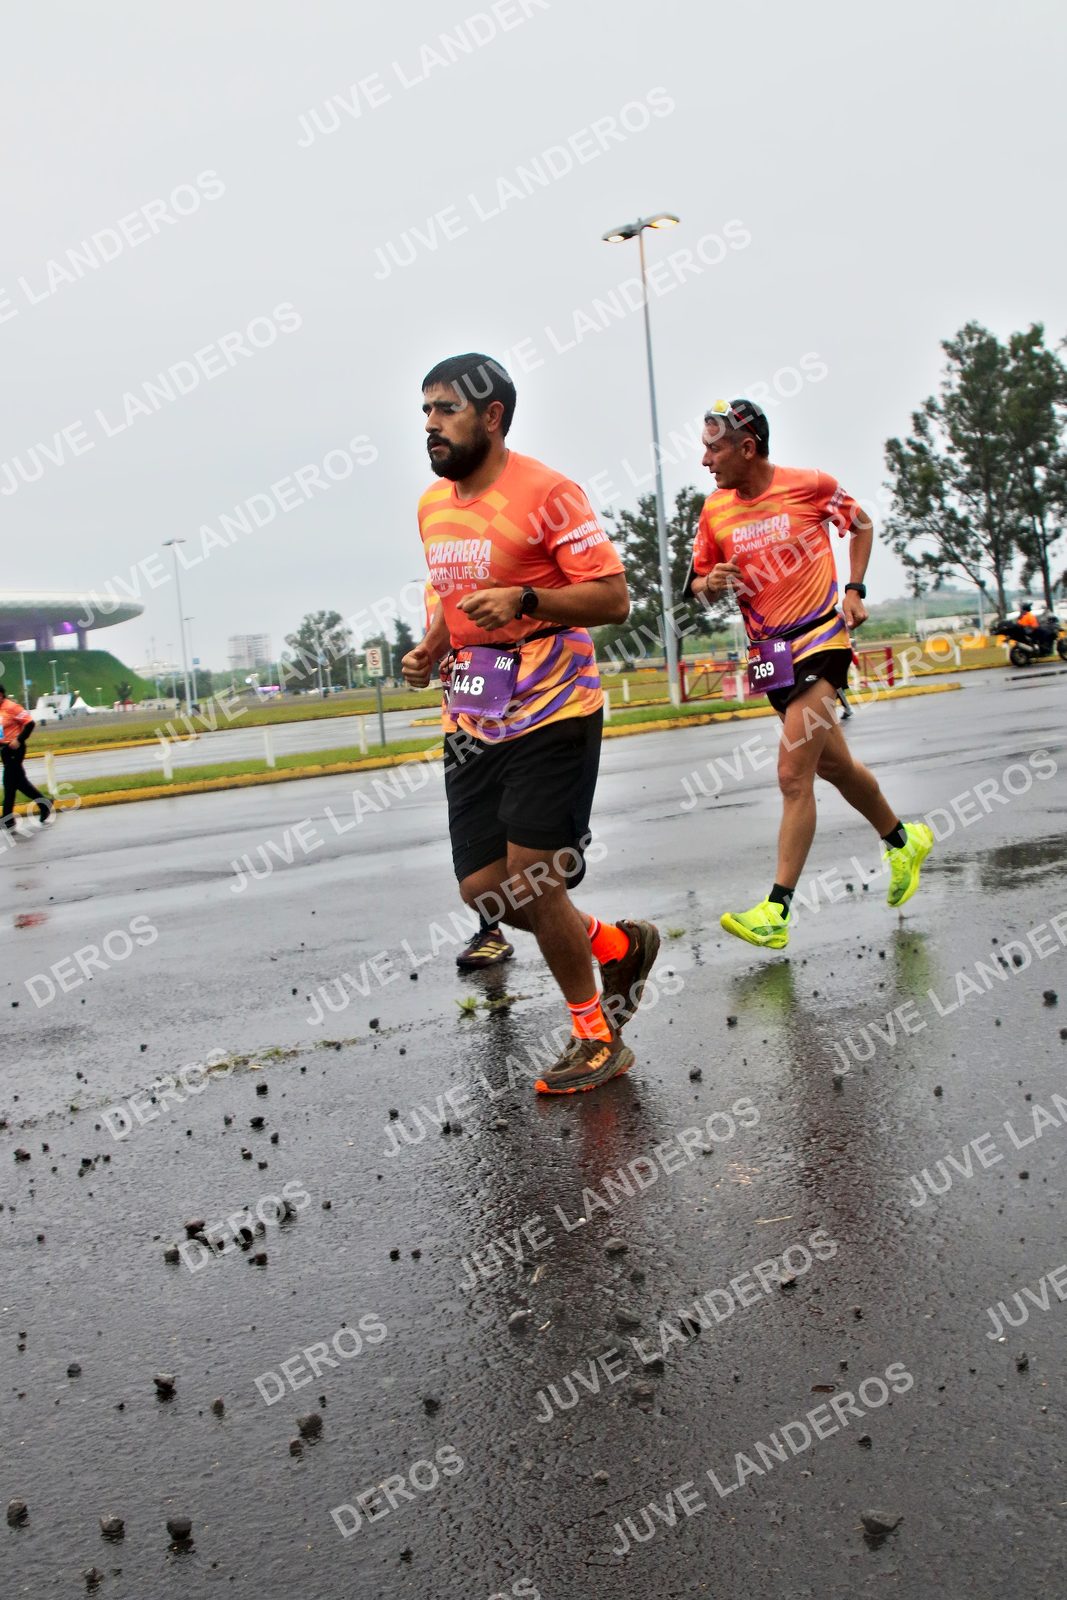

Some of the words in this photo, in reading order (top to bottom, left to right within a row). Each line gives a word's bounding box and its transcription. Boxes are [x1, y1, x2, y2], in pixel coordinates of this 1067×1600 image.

[732, 513, 790, 542] CARRERA
[429, 539, 492, 565] CARRERA
[734, 535, 777, 554] OMNILIFE
[753, 661, 775, 680] 269
[453, 675, 485, 695] 448
